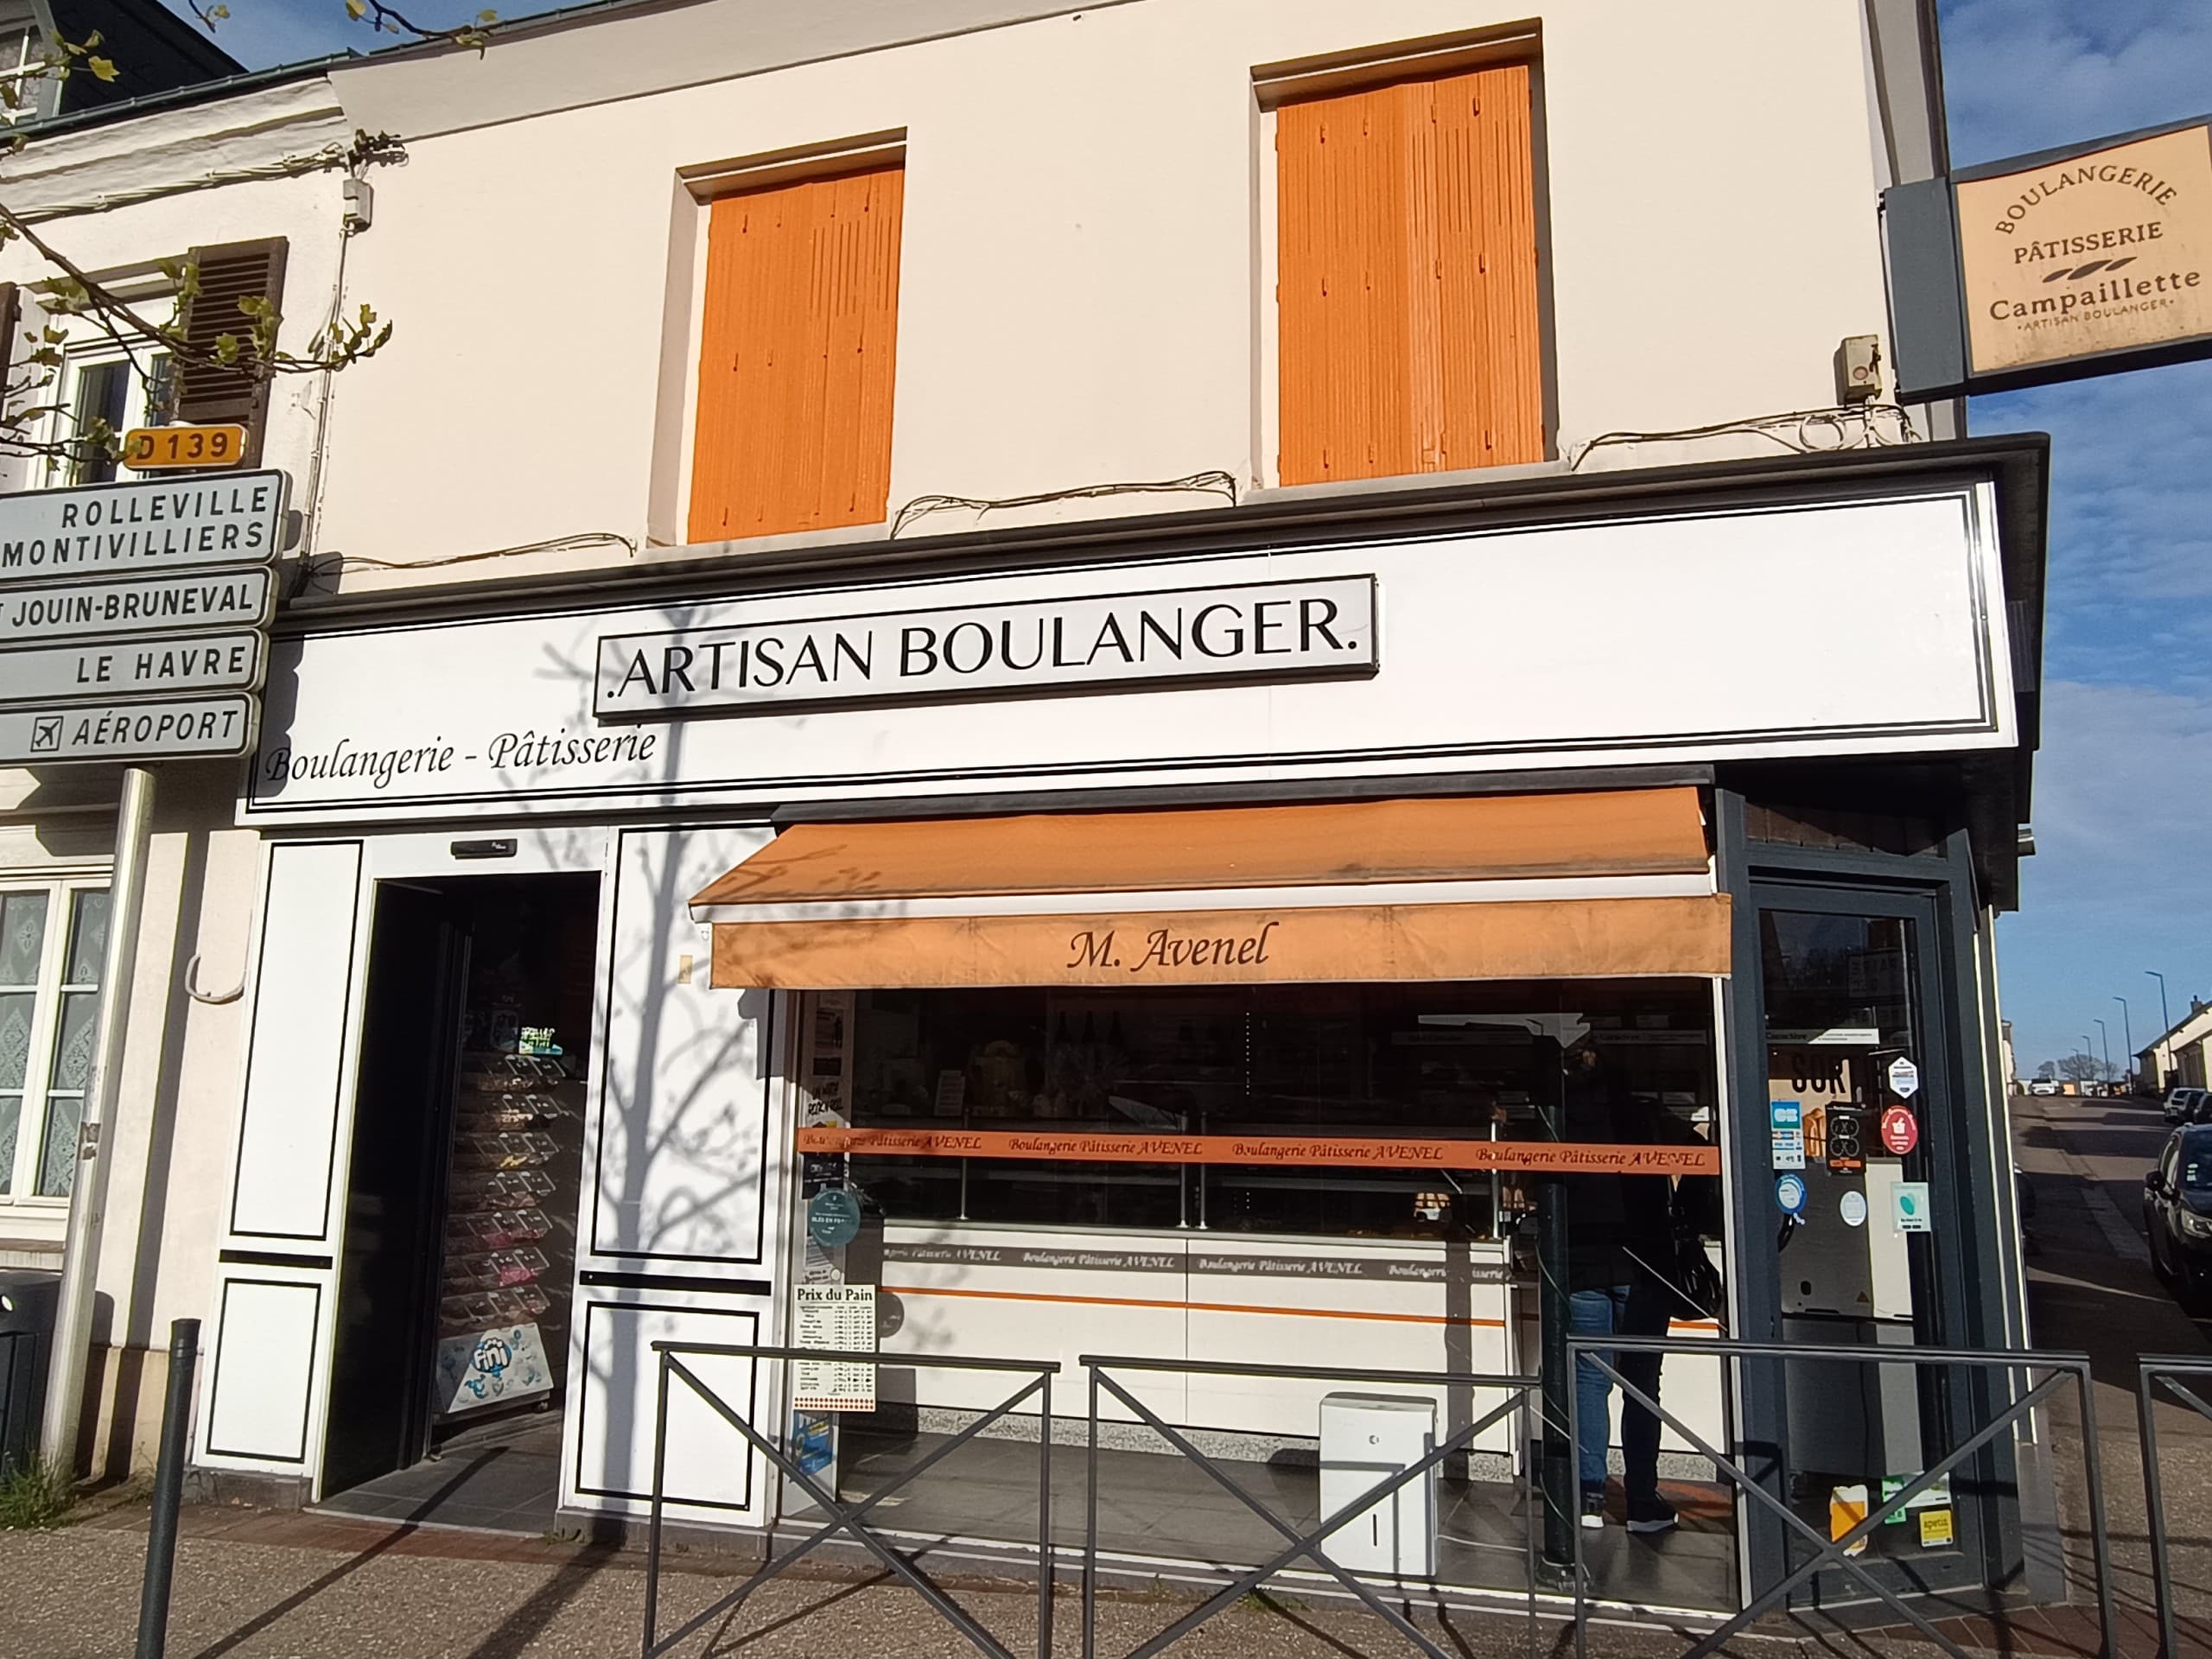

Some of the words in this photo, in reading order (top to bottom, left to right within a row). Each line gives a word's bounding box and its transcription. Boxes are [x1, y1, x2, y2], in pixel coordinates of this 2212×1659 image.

[1995, 164, 2177, 235] BOULANGERIE
[2014, 221, 2164, 264] PÂTISSERIE
[1990, 271, 2201, 320] Campaillette
[136, 435, 155, 460] D
[168, 432, 228, 460] 139
[61, 486, 269, 528] ROLLEVILLE
[2, 522, 263, 568] MONTIVILLIERS
[12, 584, 253, 627] JOUIN-BRUNEVAL
[77, 656, 113, 683] LE
[135, 646, 245, 680] HAVRE
[72, 710, 238, 746] AÉROPORT
[265, 735, 455, 790] Boulangerie
[488, 727, 657, 770] Pâtisserie
[1066, 930, 1121, 969] M.
[1129, 920, 1280, 973] Avenel
[921, 1135, 982, 1150] AVENEL
[1008, 1136, 1076, 1155] Boulangerie
[1079, 1139, 1136, 1154] Pâtisserie
[1136, 1141, 1204, 1155] AVENEL
[1309, 1143, 1371, 1159] Pâtisserie
[1371, 1145, 1444, 1160] AVENEL
[1560, 1149, 1627, 1166] Pâtisserie
[797, 1287, 823, 1301] Prix
[825, 1287, 842, 1301] du
[845, 1287, 874, 1301] Pain
